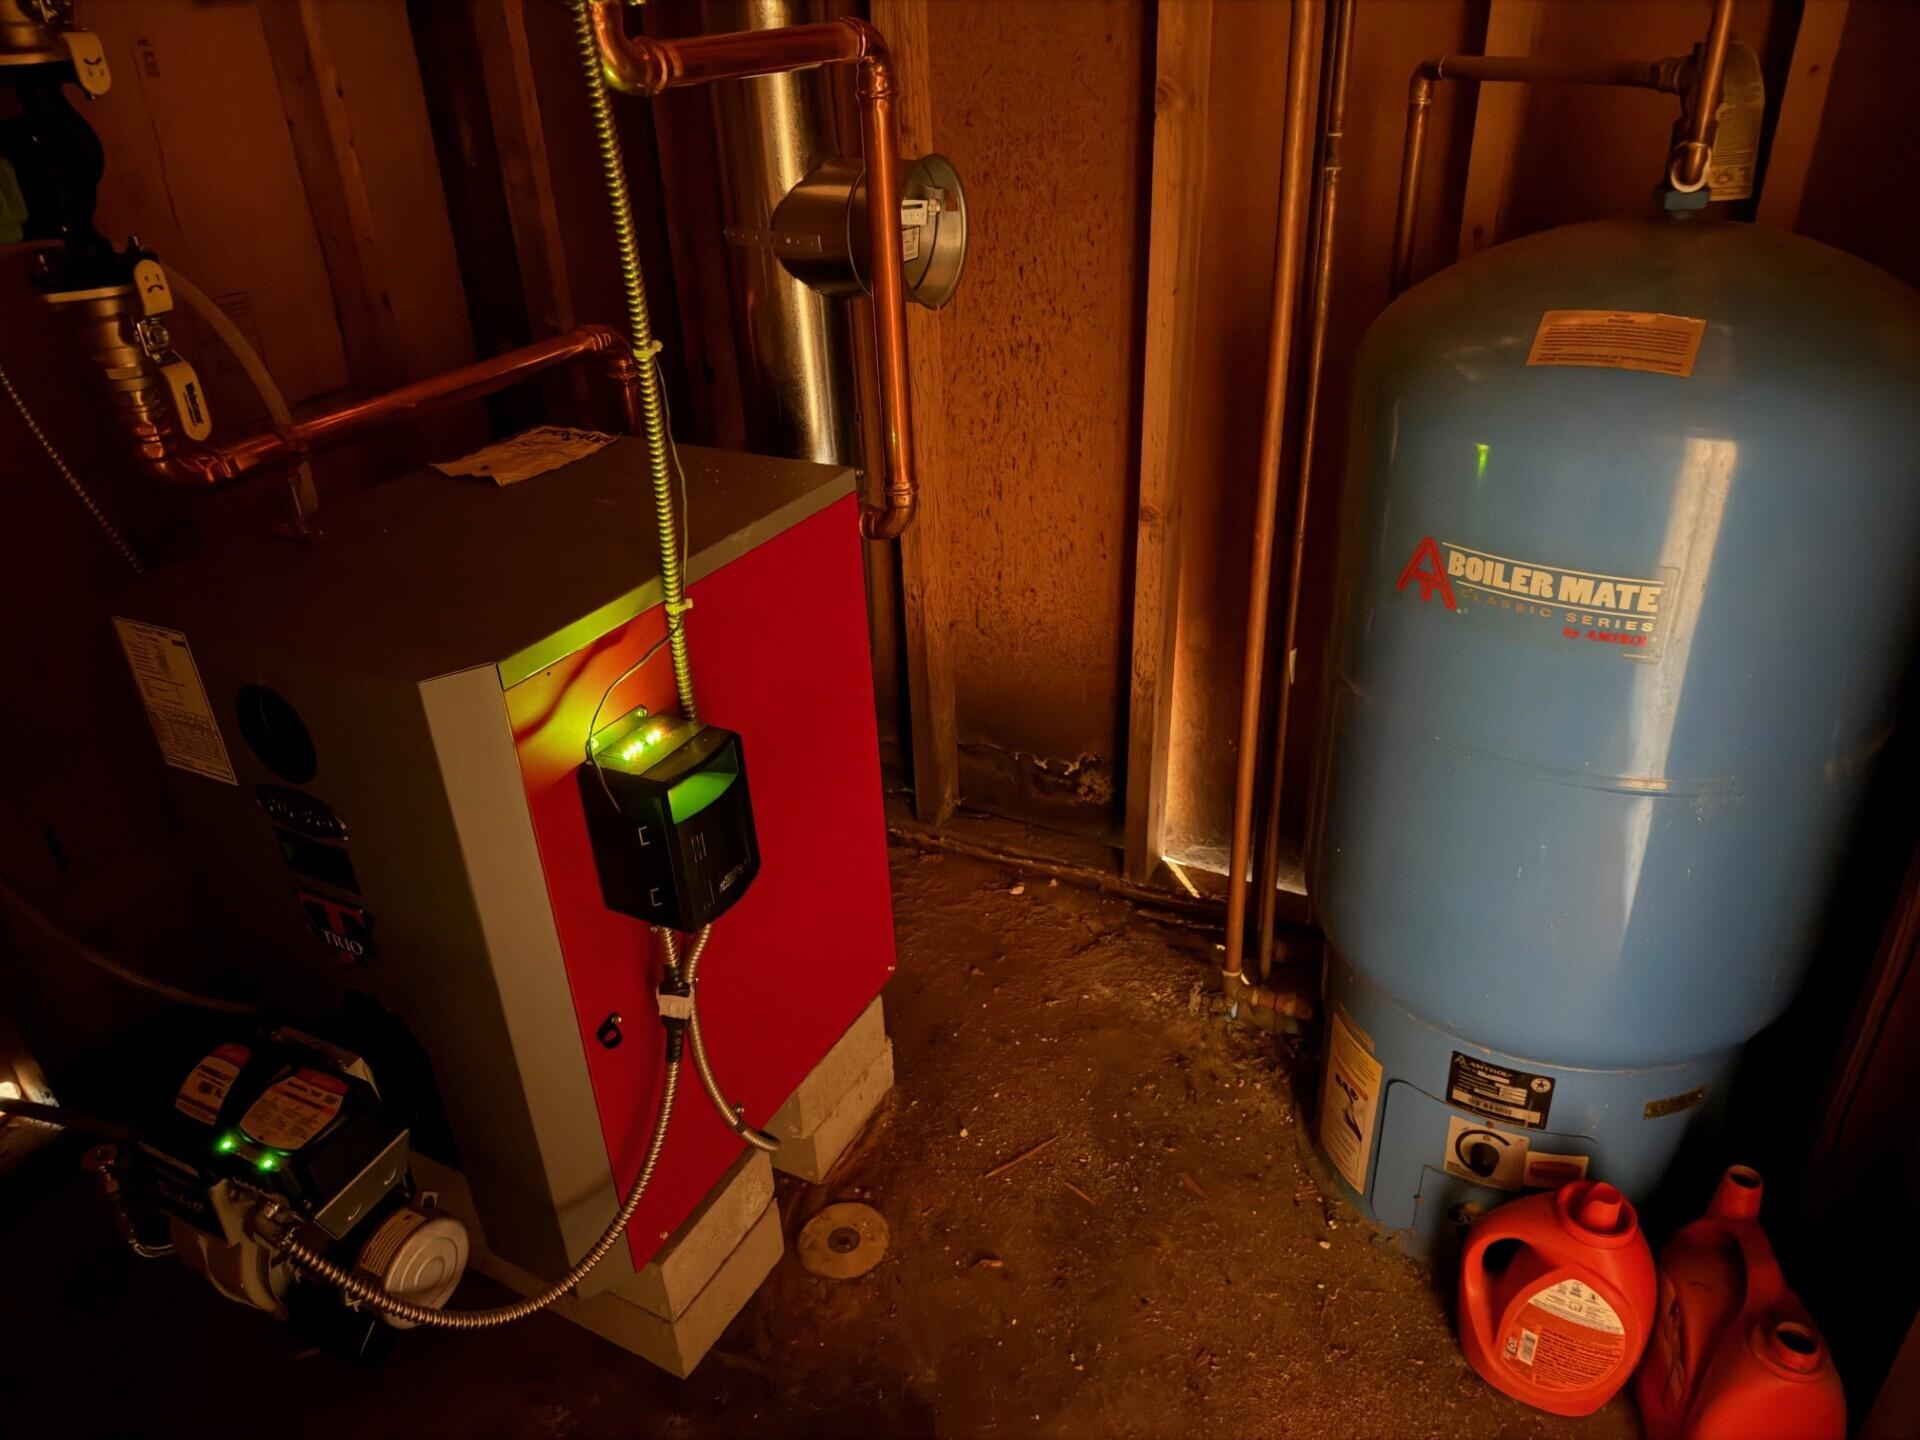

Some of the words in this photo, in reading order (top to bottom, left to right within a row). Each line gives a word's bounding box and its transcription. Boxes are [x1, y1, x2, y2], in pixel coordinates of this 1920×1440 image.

[1447, 550, 1554, 599] BOILER
[1558, 575, 1661, 613] MATE
[1461, 588, 1553, 618] CLASSIC
[1565, 612, 1655, 632] SERIES
[320, 928, 364, 956] TRIO
